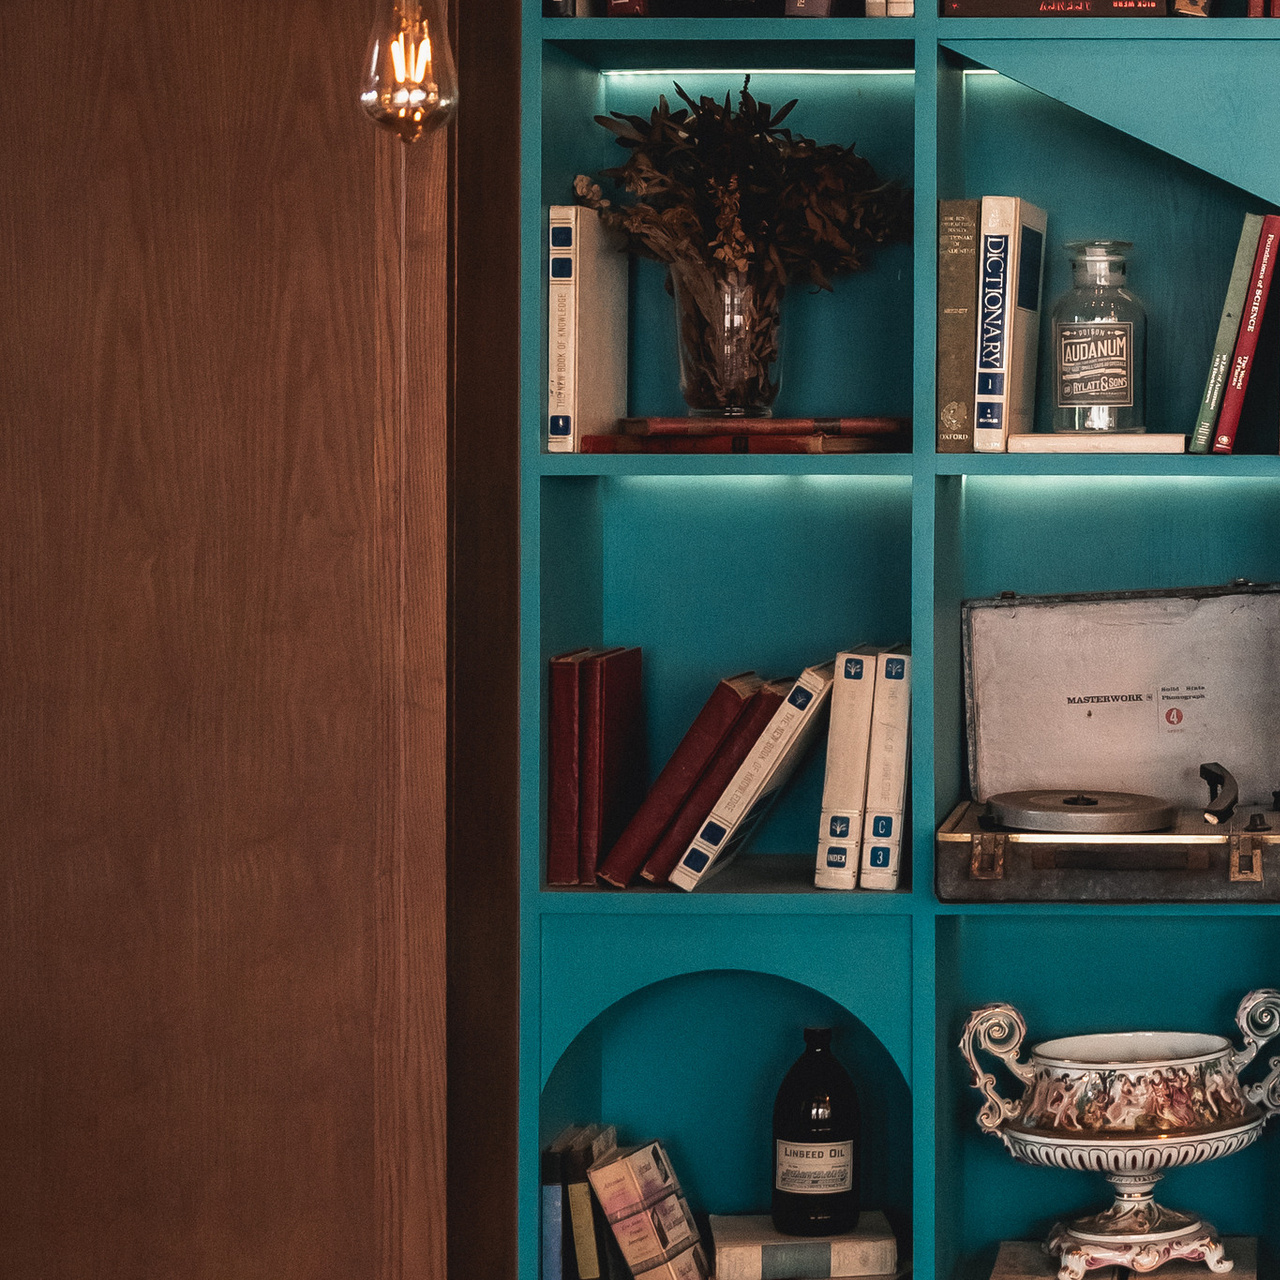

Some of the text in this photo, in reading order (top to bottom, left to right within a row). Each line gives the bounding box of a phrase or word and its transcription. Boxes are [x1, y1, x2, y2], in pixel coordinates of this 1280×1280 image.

[1247, 234, 1275, 332] Foundations SCIENCE
[982, 236, 1005, 367] DICTIONARY
[557, 293, 566, 372] BOOK OF KNOWLEDGE
[1078, 328, 1105, 337] POISON
[1073, 376, 1128, 393] RYLATT SONS
[1231, 365, 1241, 387] Plants
[1236, 369, 1246, 390] World
[1066, 694, 1143, 704] MASTERWORK
[1161, 693, 1206, 701] Phonograph
[724, 741, 774, 813] BOOK KNOWLEDGE
[827, 853, 846, 863] INDEX
[876, 851, 884, 865] 3
[784, 1147, 846, 1159] LINSEED OIL
